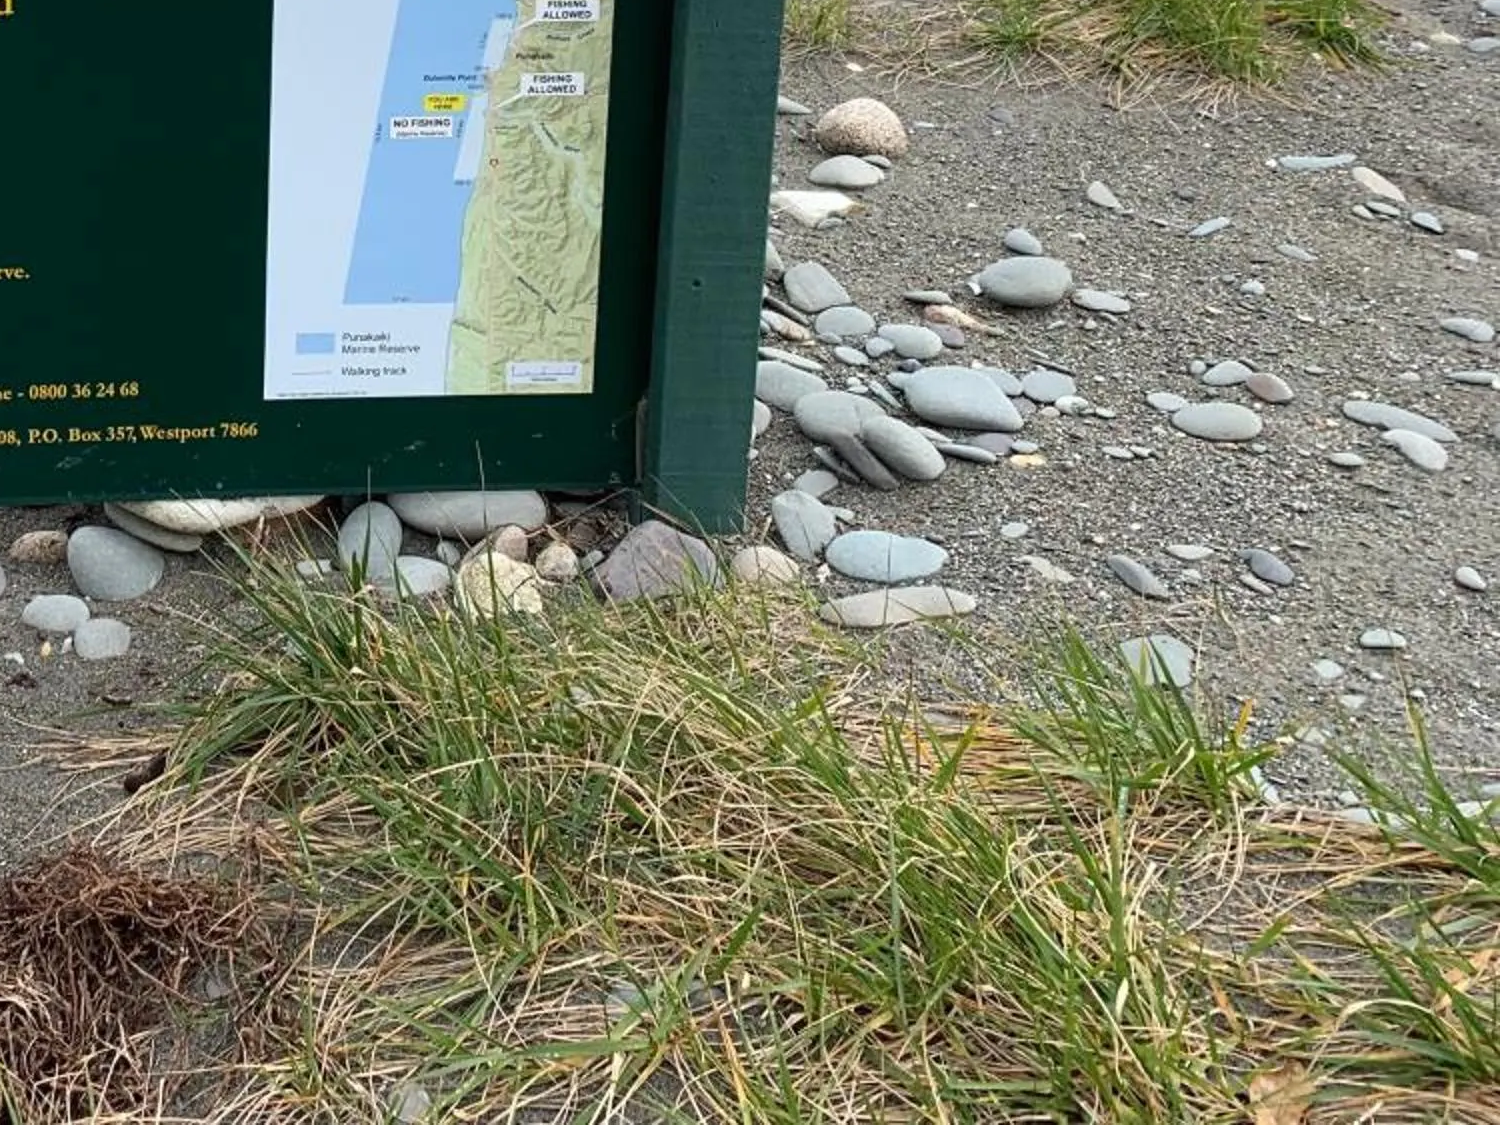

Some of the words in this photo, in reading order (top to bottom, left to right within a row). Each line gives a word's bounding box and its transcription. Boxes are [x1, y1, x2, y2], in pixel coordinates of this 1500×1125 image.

[547, 0, 588, 9] FISHING
[542, 10, 592, 20] ALLOWED
[533, 74, 573, 83] FISHING
[527, 84, 577, 94] ALLOWED
[394, 119, 409, 128] NO
[411, 118, 451, 128] FISHING
[28, 384, 67, 400] 0800
[71, 382, 92, 398] 36
[95, 382, 115, 398] 24
[119, 381, 140, 397] 68
[28, 427, 63, 444] P.O.
[68, 427, 101, 442] Box
[105, 425, 137, 444] 357,
[139, 425, 216, 444] Westport
[220, 421, 258, 438] 7866
